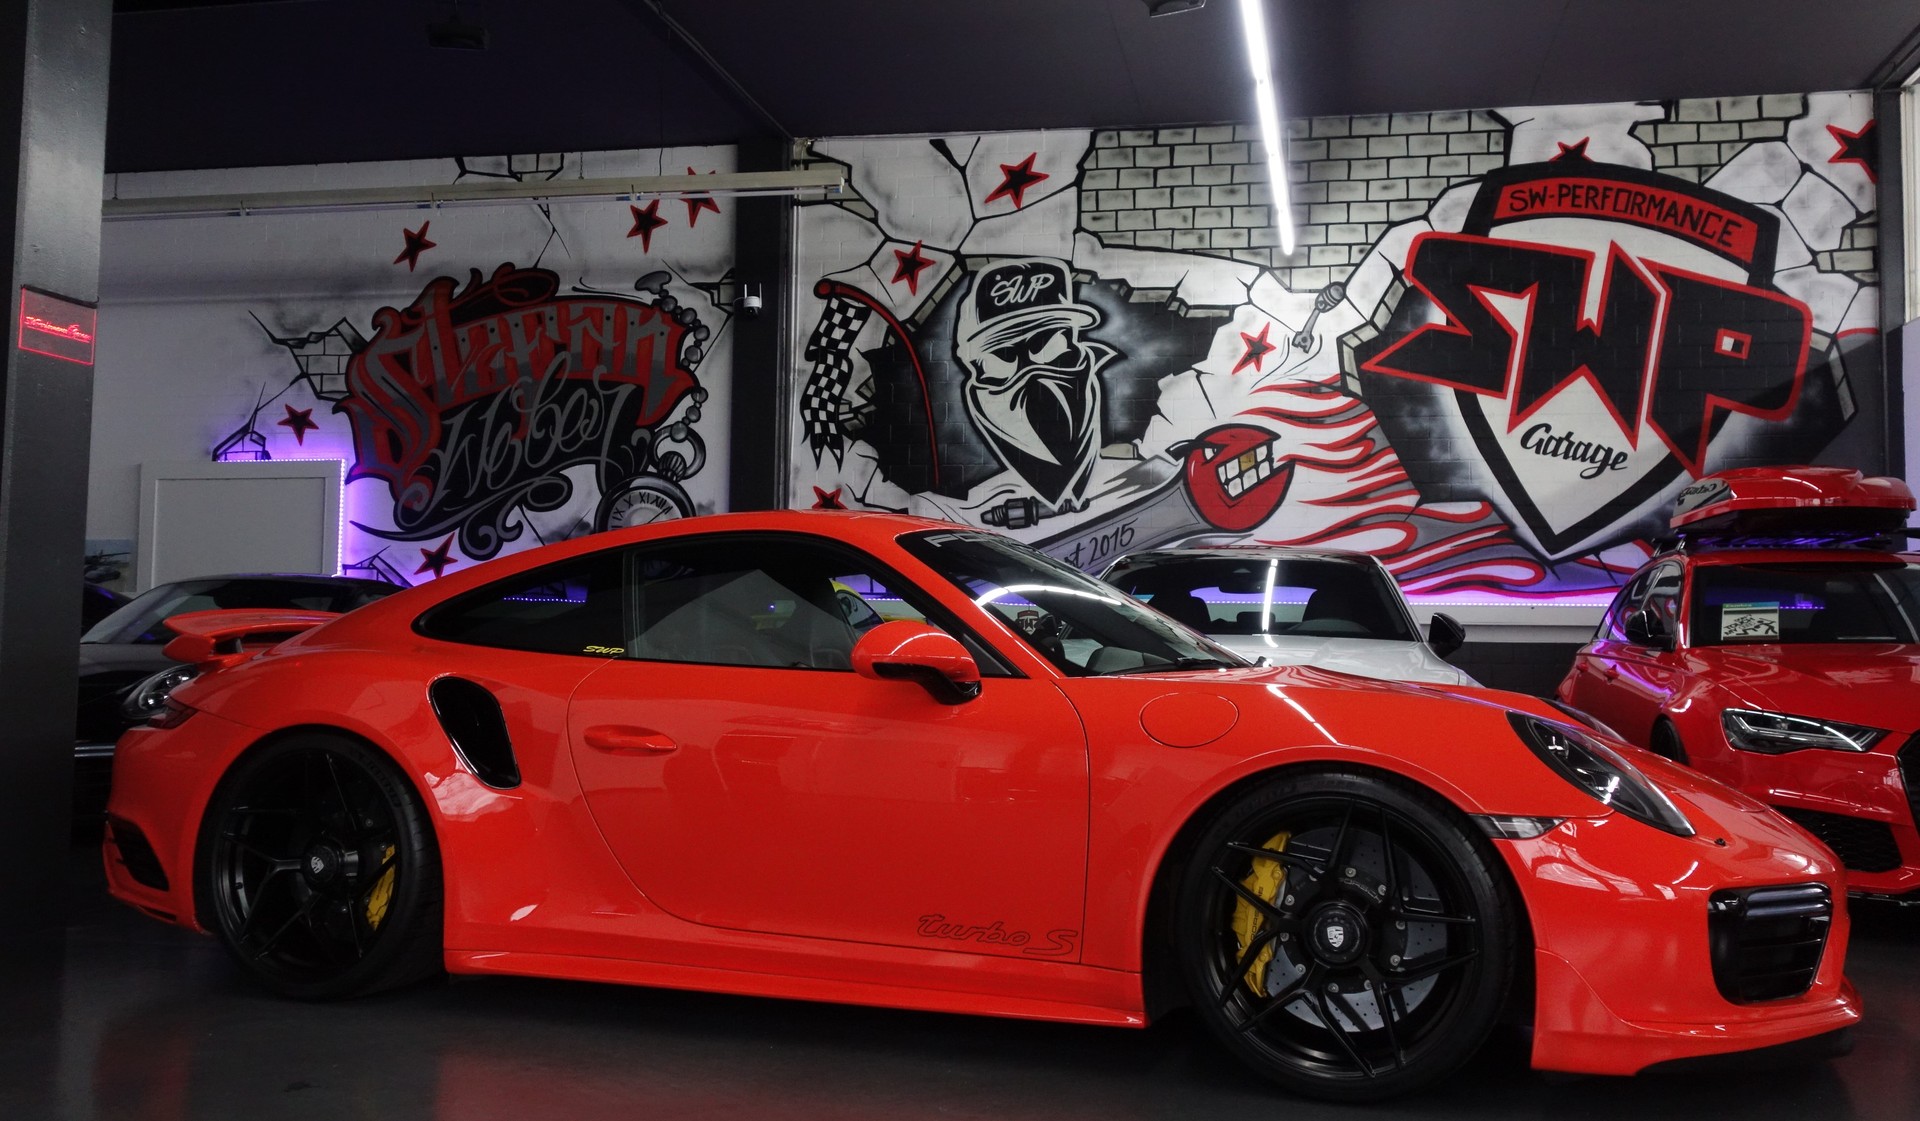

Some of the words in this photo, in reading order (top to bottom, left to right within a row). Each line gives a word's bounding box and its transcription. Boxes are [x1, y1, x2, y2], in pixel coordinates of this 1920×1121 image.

[1508, 184, 1744, 249] SW-PERFORMANCE
[990, 273, 1055, 306] SWP
[1360, 231, 1814, 481] SWP
[1519, 423, 1629, 479] Garage
[1089, 517, 1139, 564] 2015
[917, 914, 1031, 947] turbo
[1022, 929, 1079, 957] S
[1250, 886, 1264, 942] PORSE
